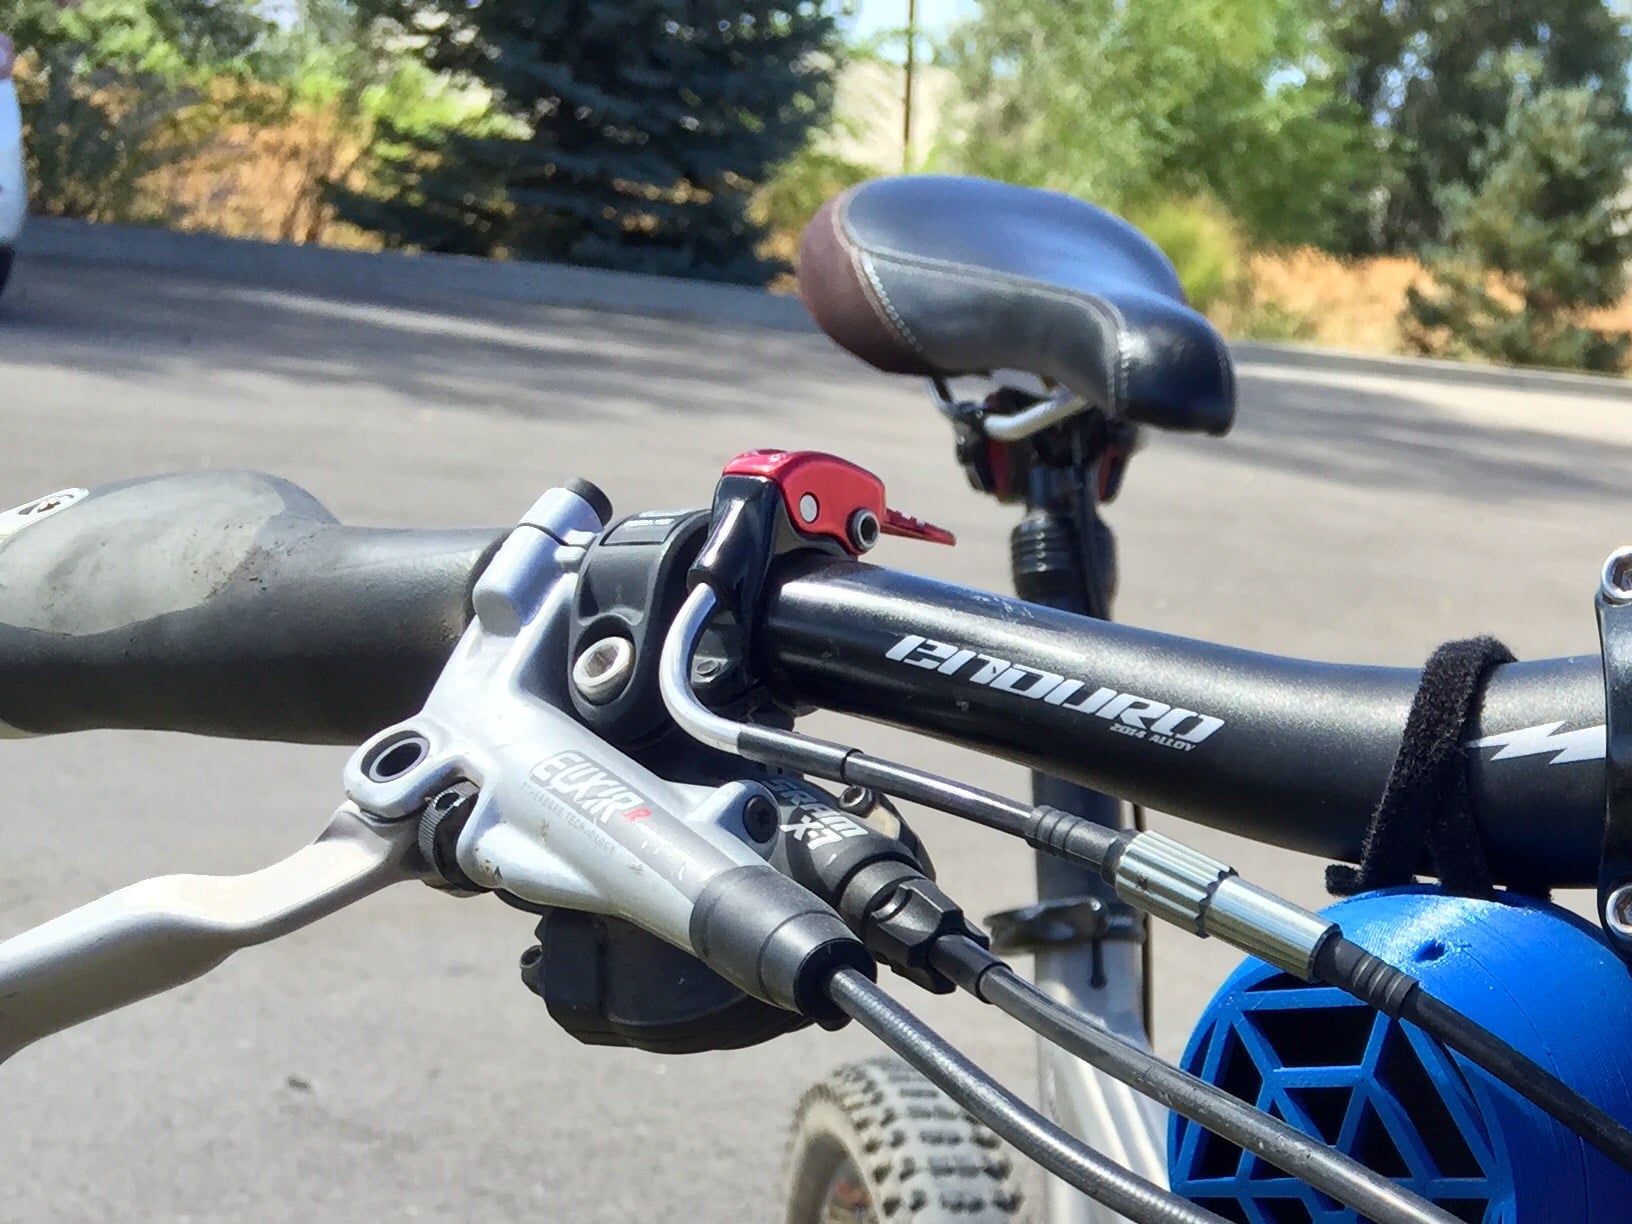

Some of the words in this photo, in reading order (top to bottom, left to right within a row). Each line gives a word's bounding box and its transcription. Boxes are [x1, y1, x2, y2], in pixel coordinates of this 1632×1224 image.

[885, 634, 1225, 743] ENDURO
[1148, 734, 1197, 752] ALLOY
[532, 752, 645, 823] ELIXIR
[761, 779, 869, 838] SRAM
